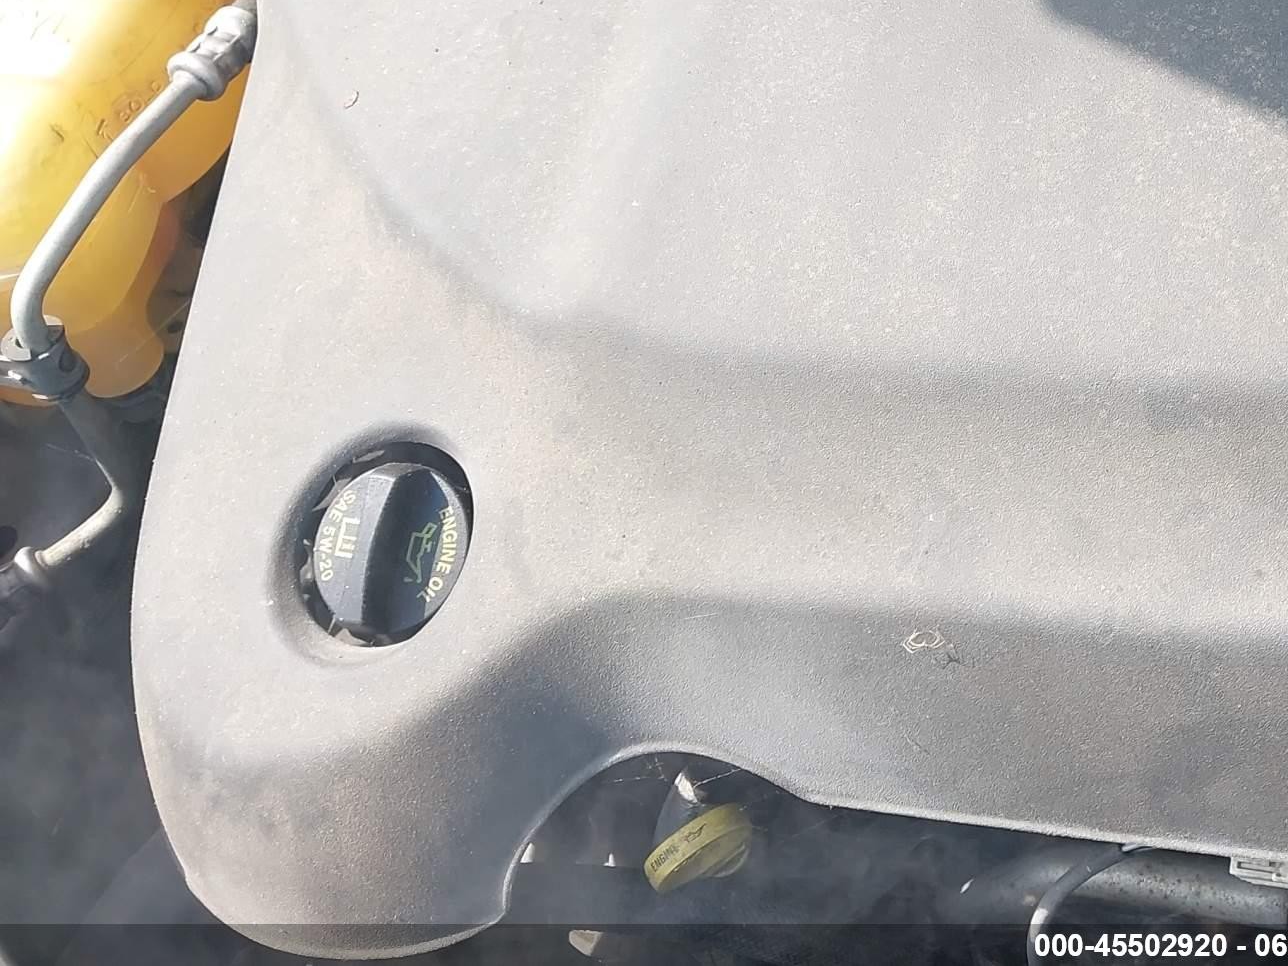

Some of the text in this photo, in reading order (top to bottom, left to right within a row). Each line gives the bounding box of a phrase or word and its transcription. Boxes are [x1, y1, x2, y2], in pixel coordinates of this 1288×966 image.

[319, 489, 357, 582] SAE 5W-20
[416, 506, 459, 603] ENGINE OIL
[650, 843, 681, 872] ENGINE
